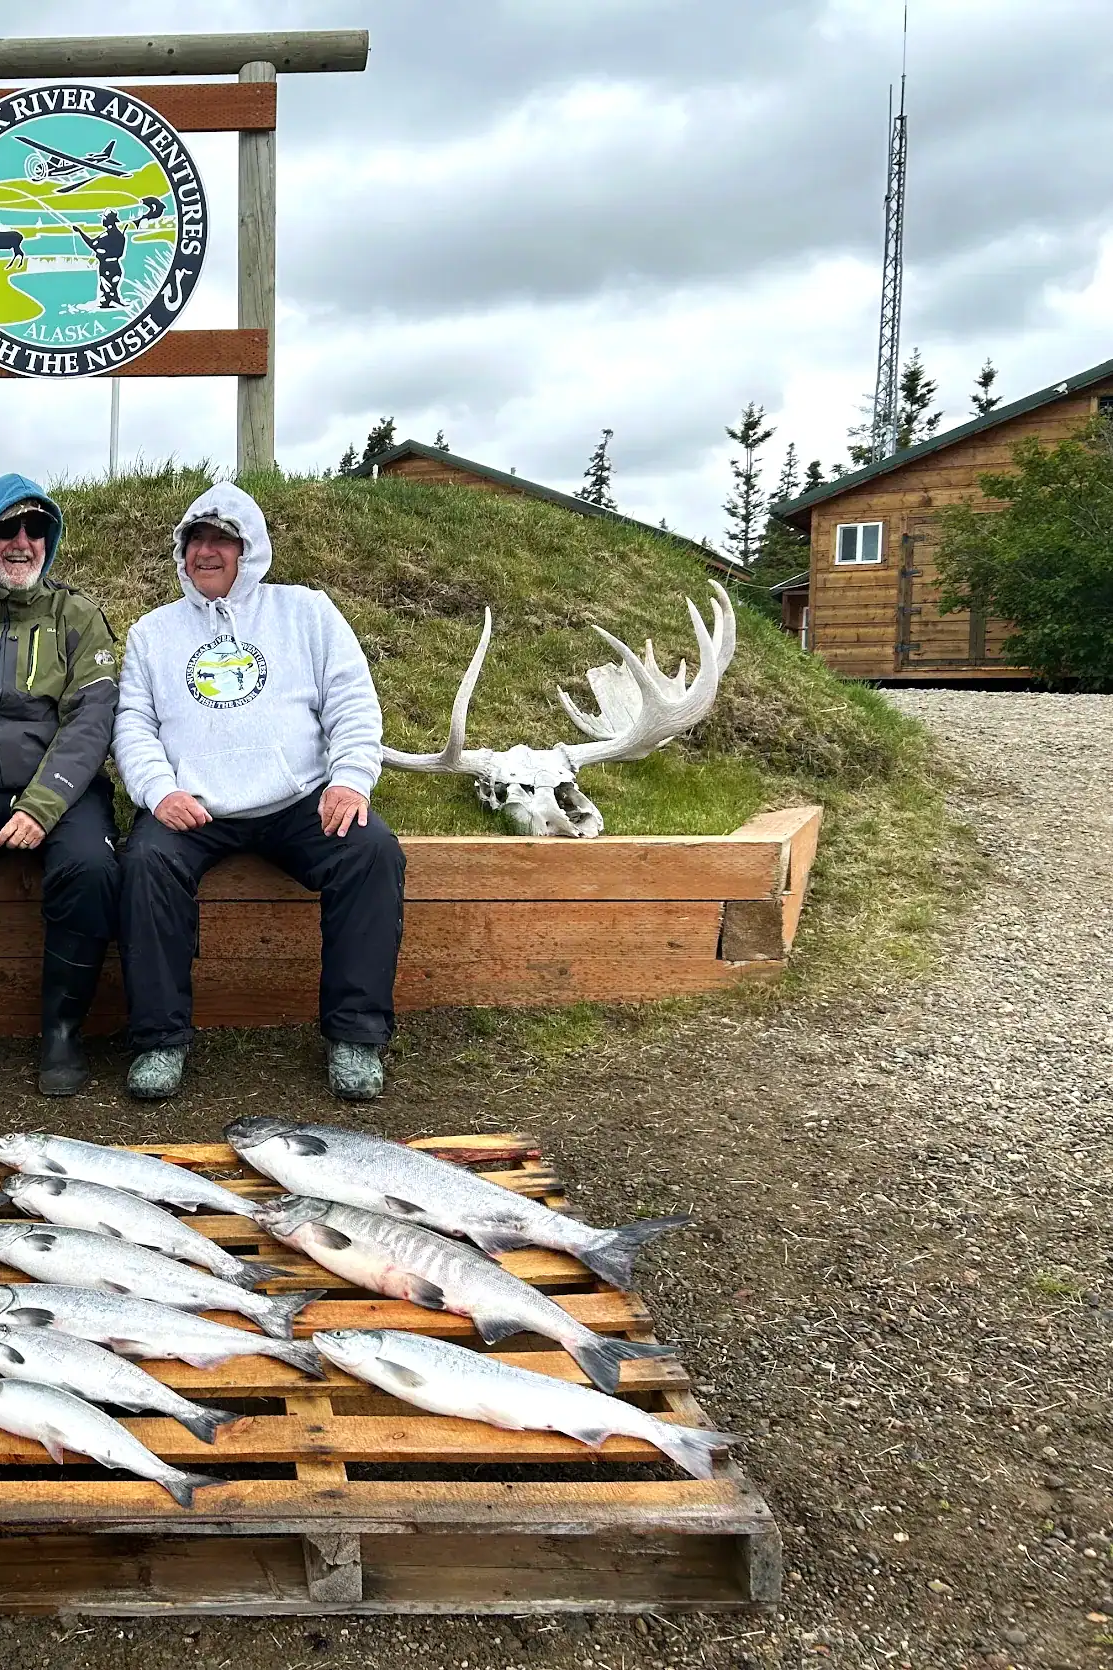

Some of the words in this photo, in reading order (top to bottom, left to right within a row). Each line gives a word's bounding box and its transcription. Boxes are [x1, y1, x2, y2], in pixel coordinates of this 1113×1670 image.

[9, 88, 97, 121] RIVER
[100, 97, 204, 256] ADVENTURES
[23, 319, 108, 343] ALASKA
[25, 348, 80, 374] THE
[85, 313, 164, 372] NUSH
